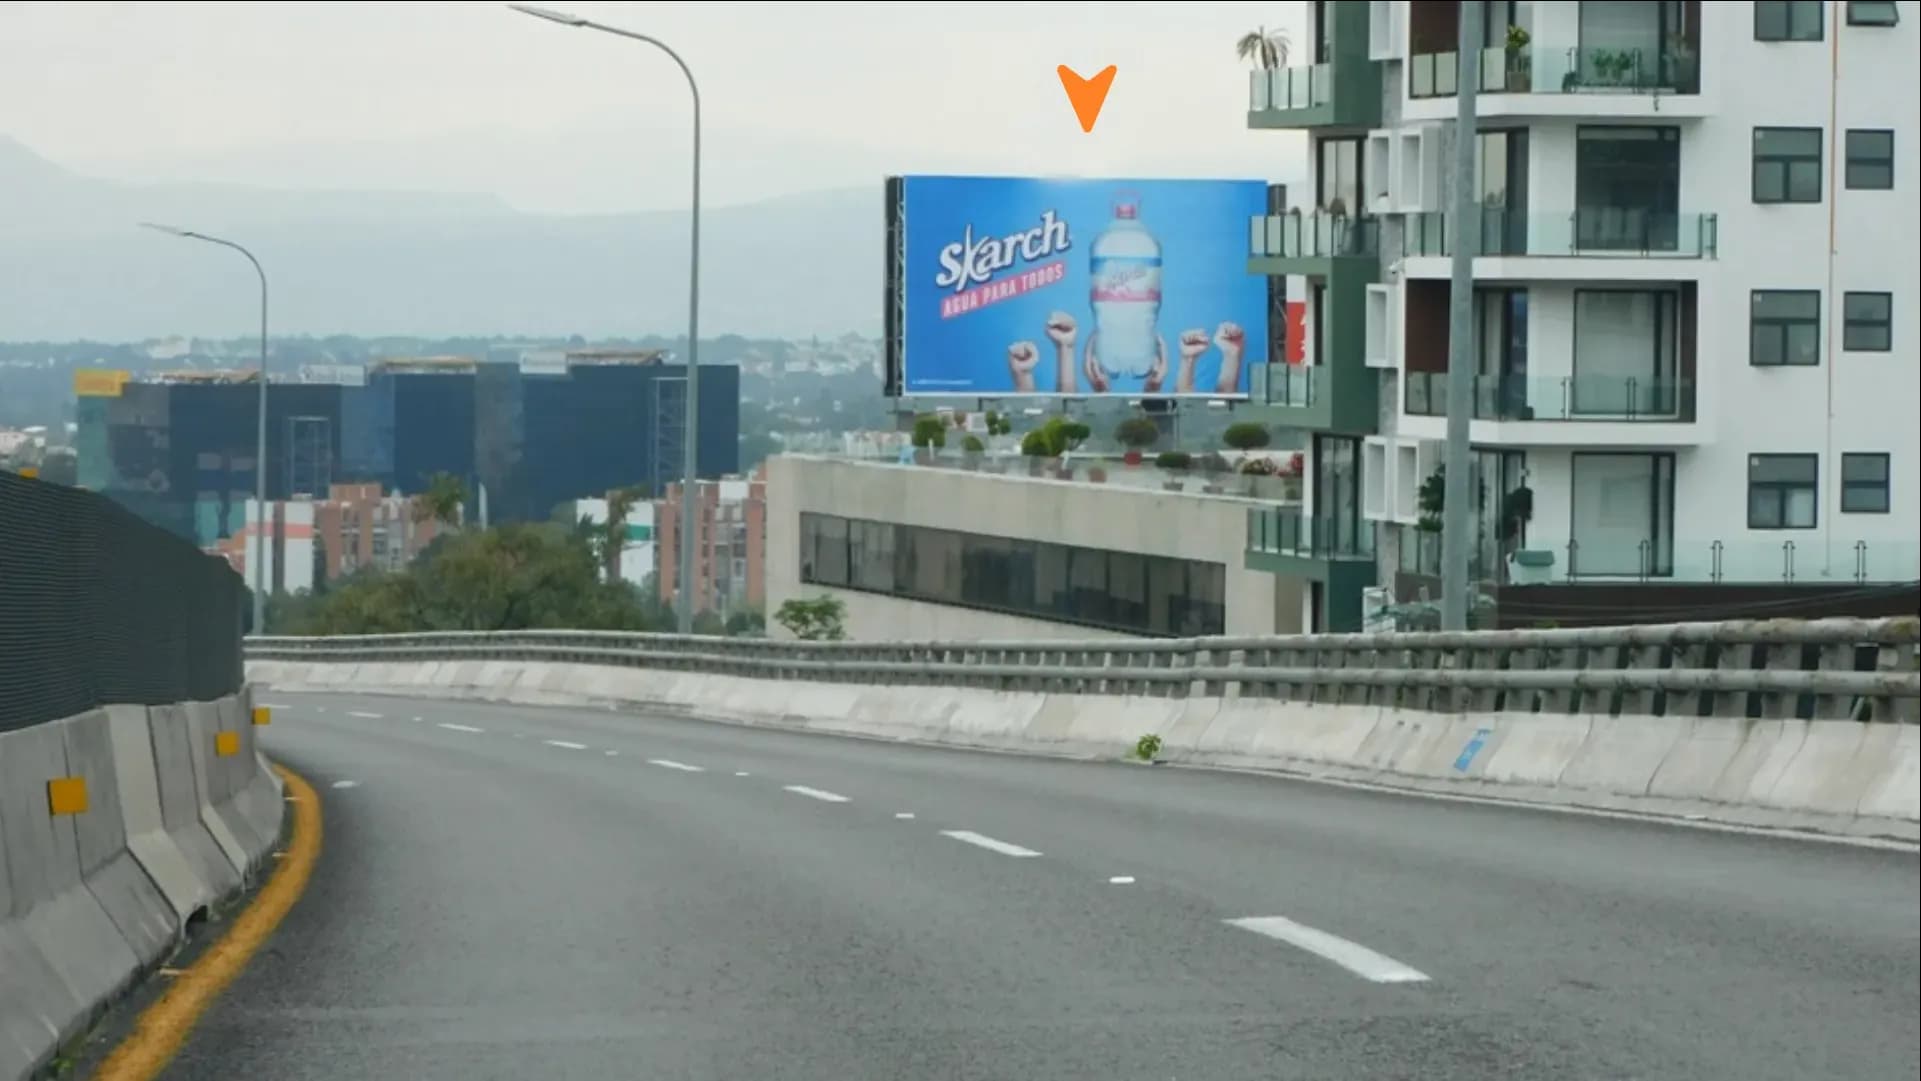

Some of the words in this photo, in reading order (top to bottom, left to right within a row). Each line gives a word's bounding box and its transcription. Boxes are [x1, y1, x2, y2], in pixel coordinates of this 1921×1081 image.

[936, 210, 1070, 292] Skarch
[943, 294, 978, 318] AGUA
[983, 280, 1017, 304] PARA
[1021, 263, 1064, 290] TODOS
